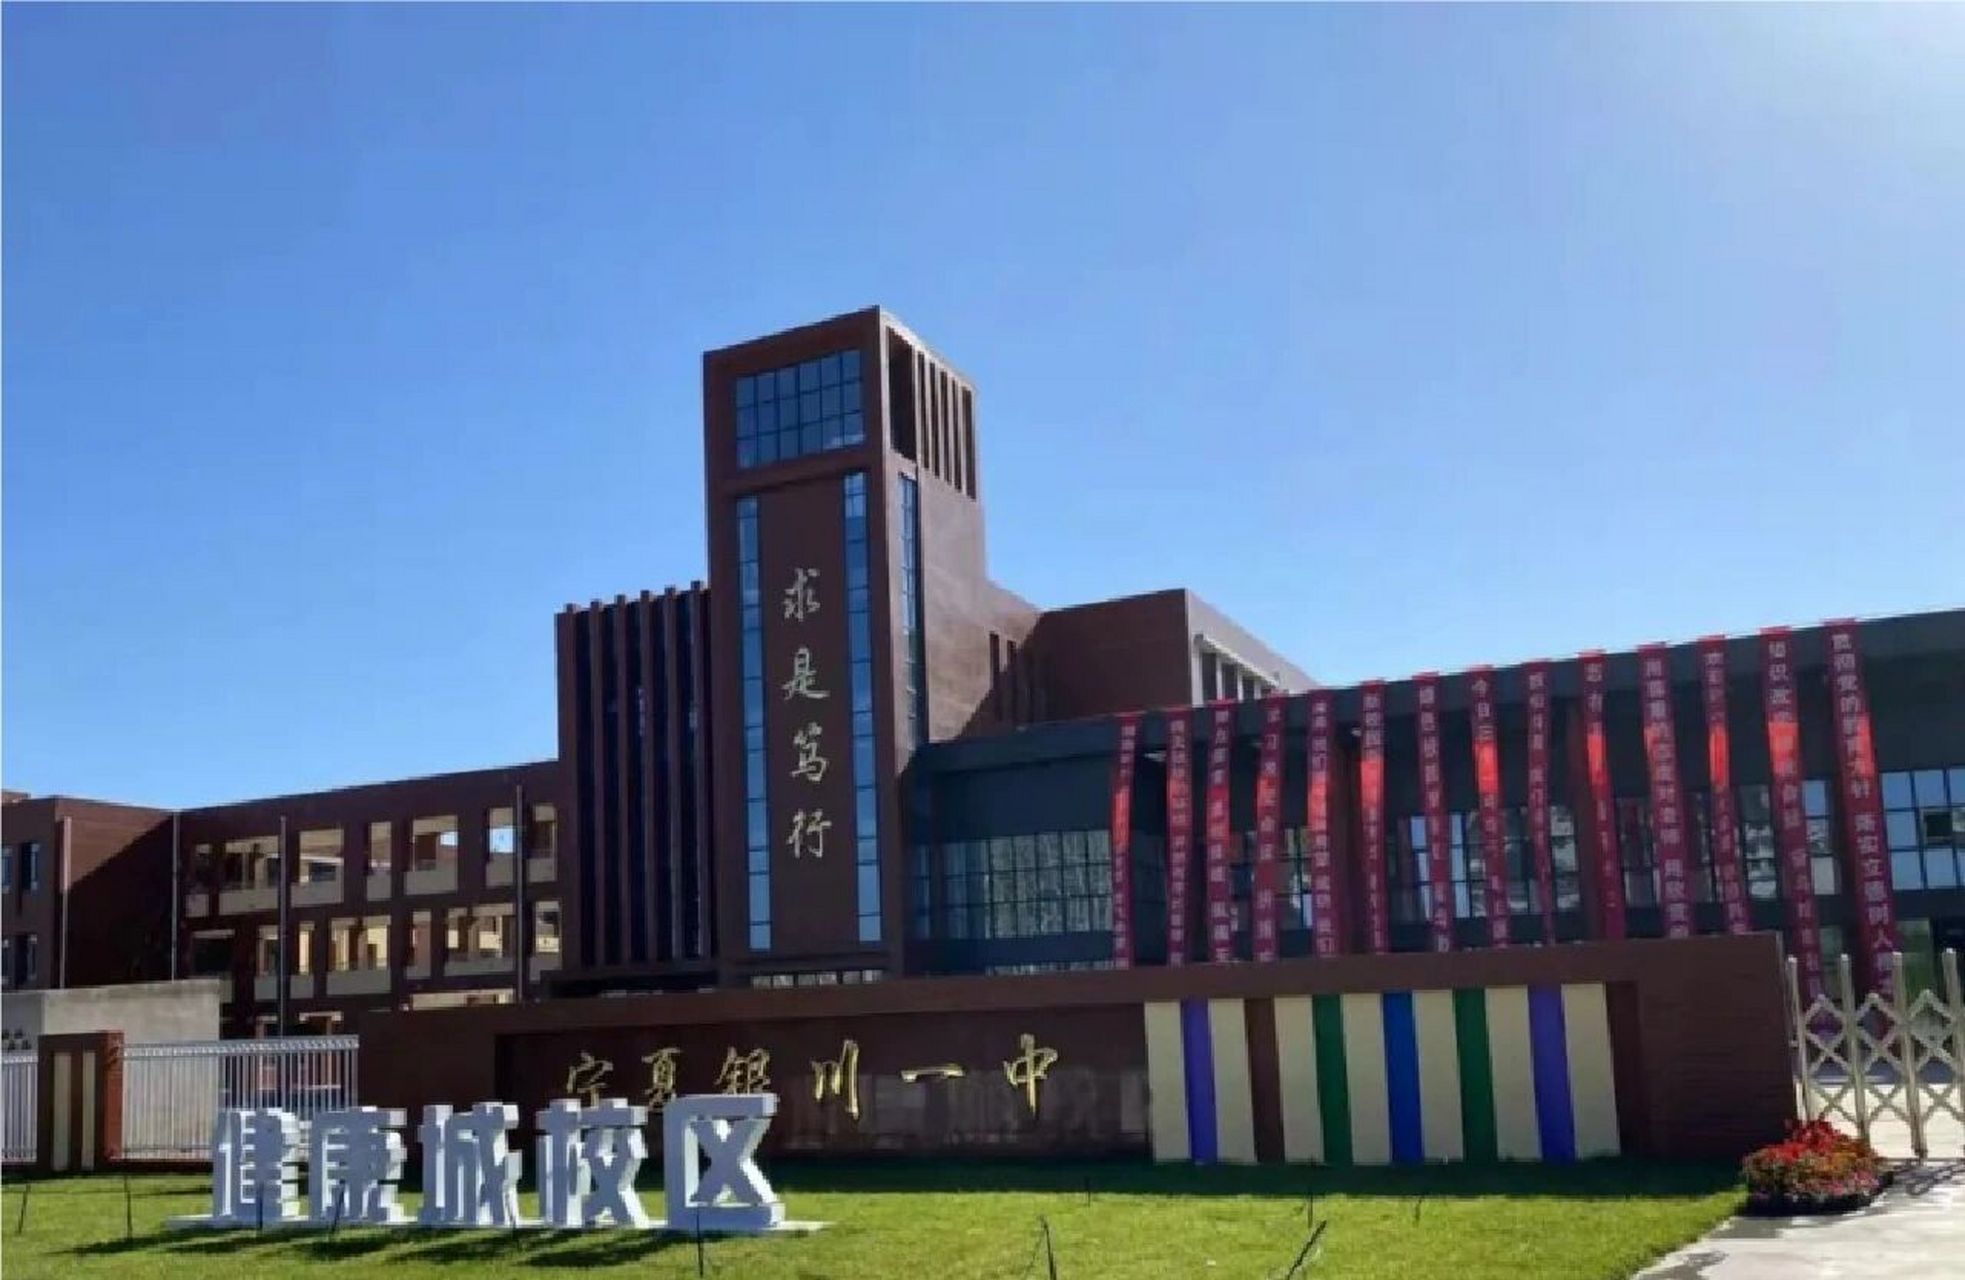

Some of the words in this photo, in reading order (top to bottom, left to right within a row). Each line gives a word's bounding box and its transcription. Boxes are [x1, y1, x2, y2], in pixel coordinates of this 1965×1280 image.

[781, 566, 833, 860] 求是笃行
[566, 1033, 1060, 1119] 宁夏银川一中
[211, 1093, 787, 1228] 健康城校区
